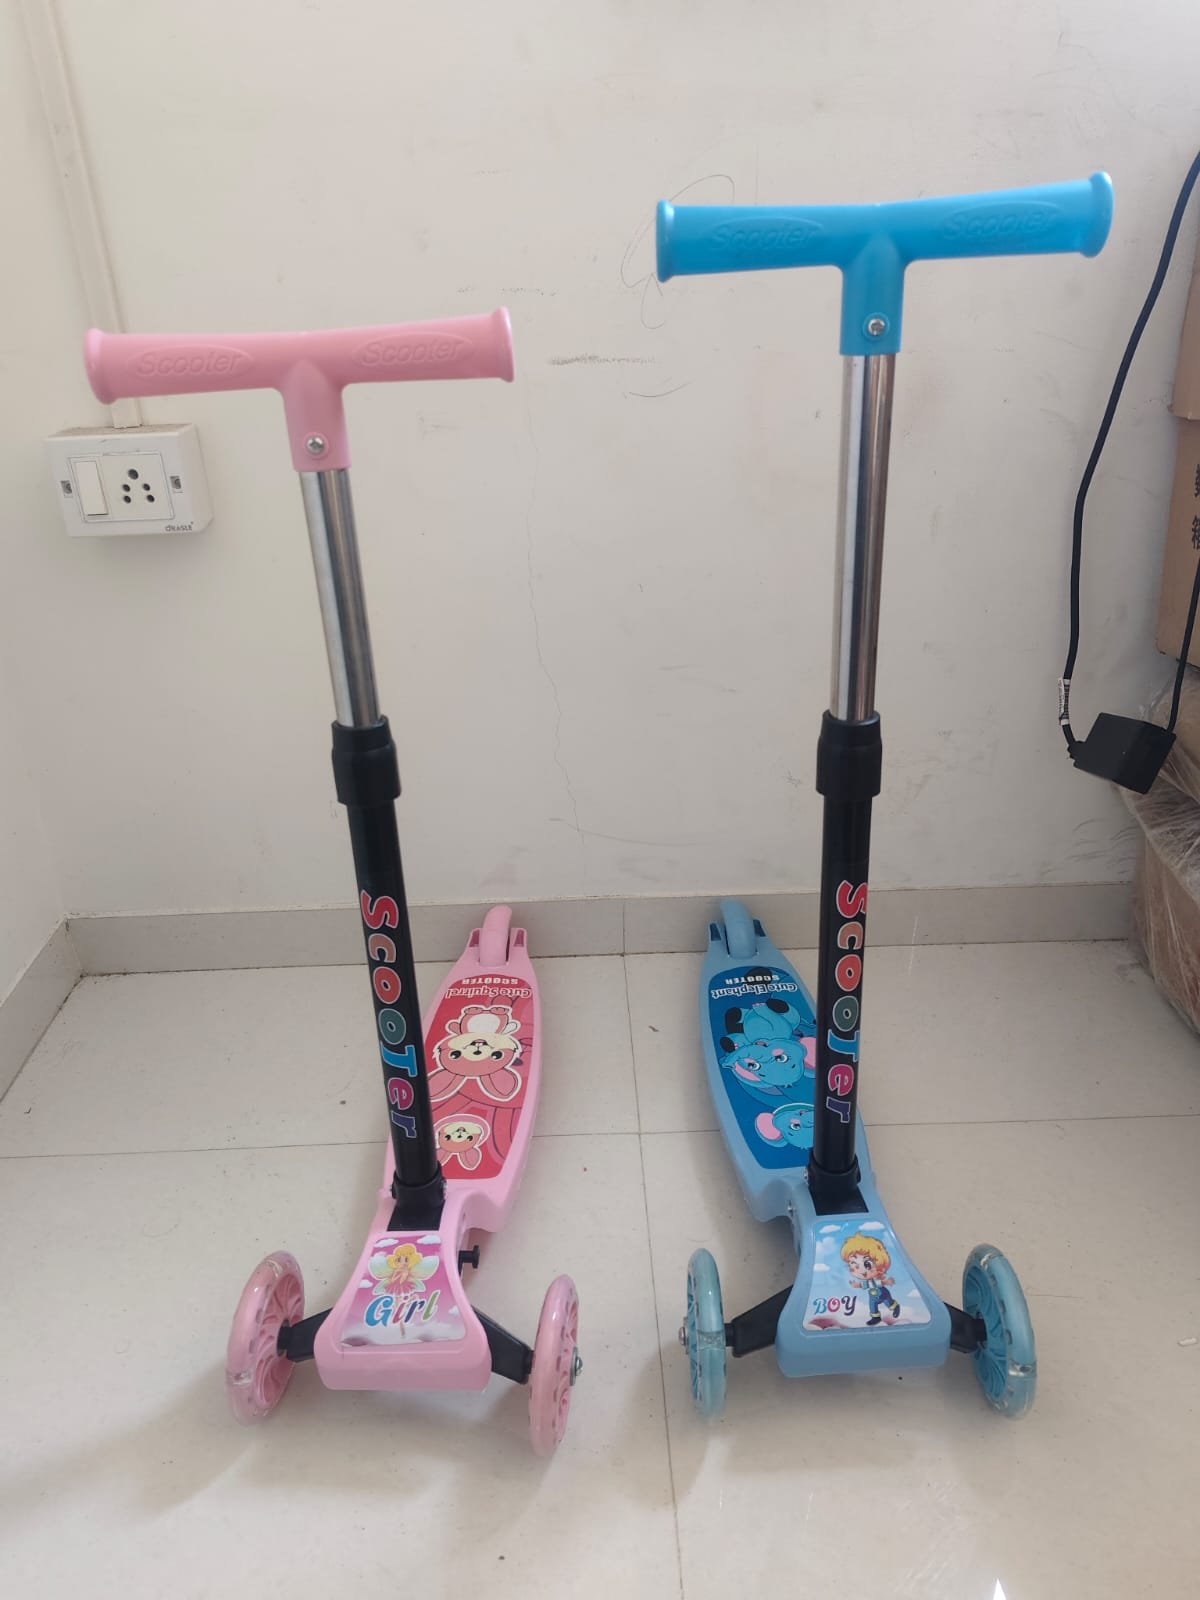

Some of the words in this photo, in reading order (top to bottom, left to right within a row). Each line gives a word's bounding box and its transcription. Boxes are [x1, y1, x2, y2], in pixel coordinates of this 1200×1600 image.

[943, 205, 1058, 241] Scooter
[709, 222, 818, 252] Scooter
[361, 335, 464, 368] Scooter
[136, 350, 242, 378] Scooter
[725, 975, 780, 984] SCOOTER
[768, 983, 798, 991] Cute
[445, 985, 499, 999] Squirrel
[500, 987, 532, 999] Cute
[711, 984, 767, 999] Elephant
[364, 1290, 441, 1327] Girl
[813, 1296, 857, 1316] BOY
